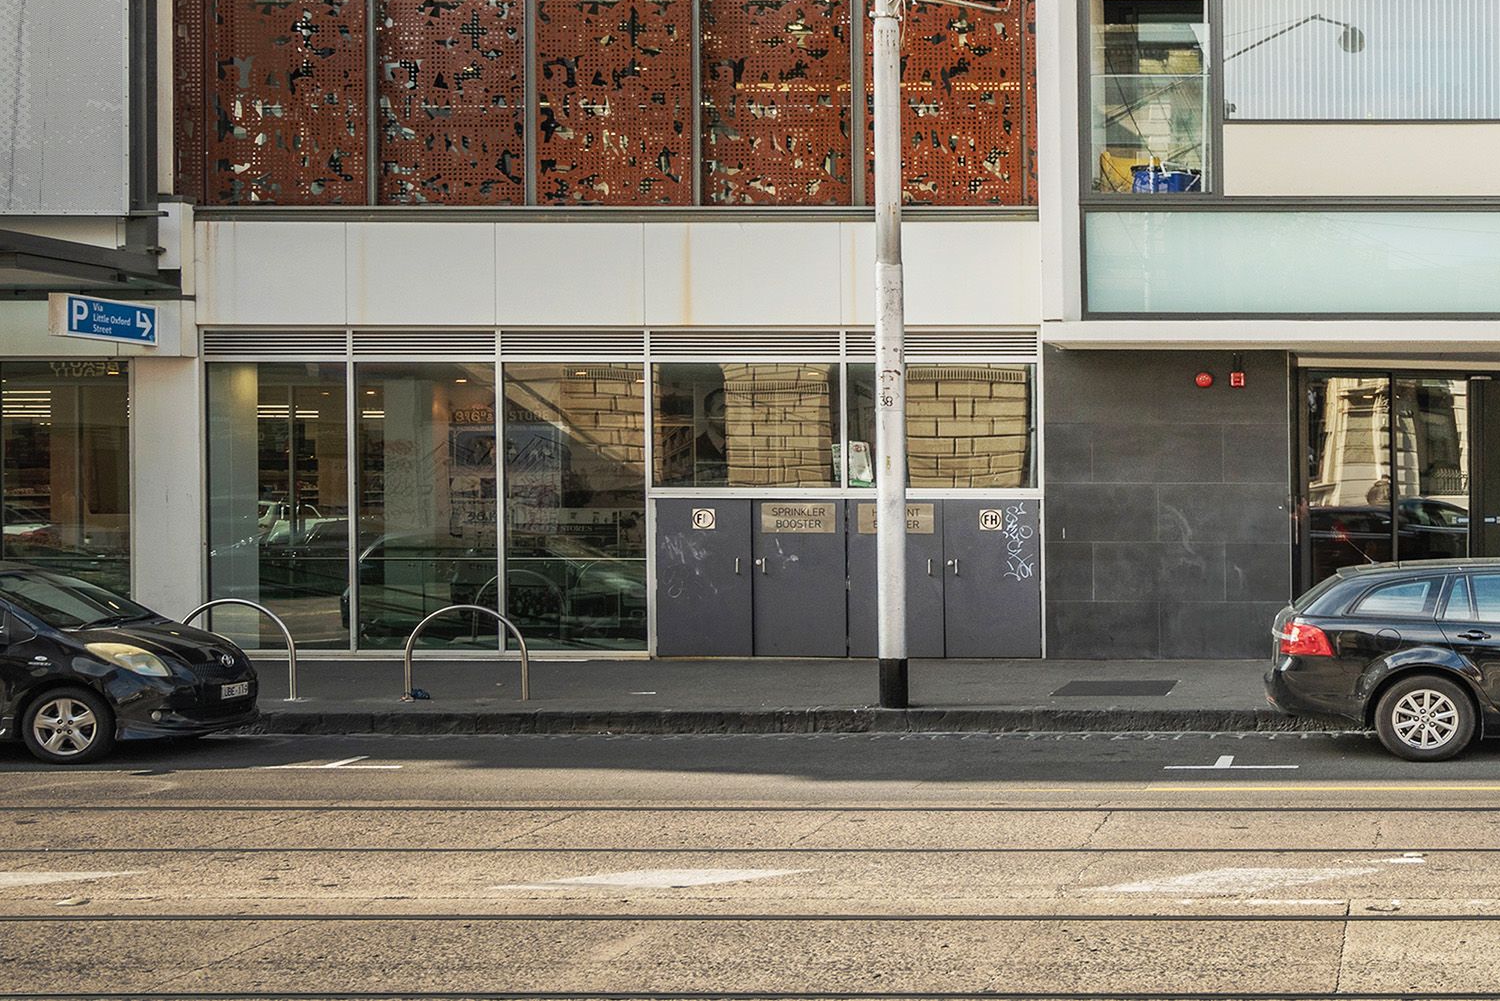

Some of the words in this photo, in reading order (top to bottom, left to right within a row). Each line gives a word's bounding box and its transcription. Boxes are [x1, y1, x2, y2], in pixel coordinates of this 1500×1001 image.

[92, 302, 104, 312] Via
[72, 299, 89, 330] P
[93, 313, 110, 324] Little
[110, 315, 131, 326] Oxford
[93, 324, 112, 334] Street
[880, 395, 893, 407] 38
[772, 508, 825, 517] SPRINKLER
[776, 520, 821, 529] BOOSTER
[984, 515, 998, 525] FH
